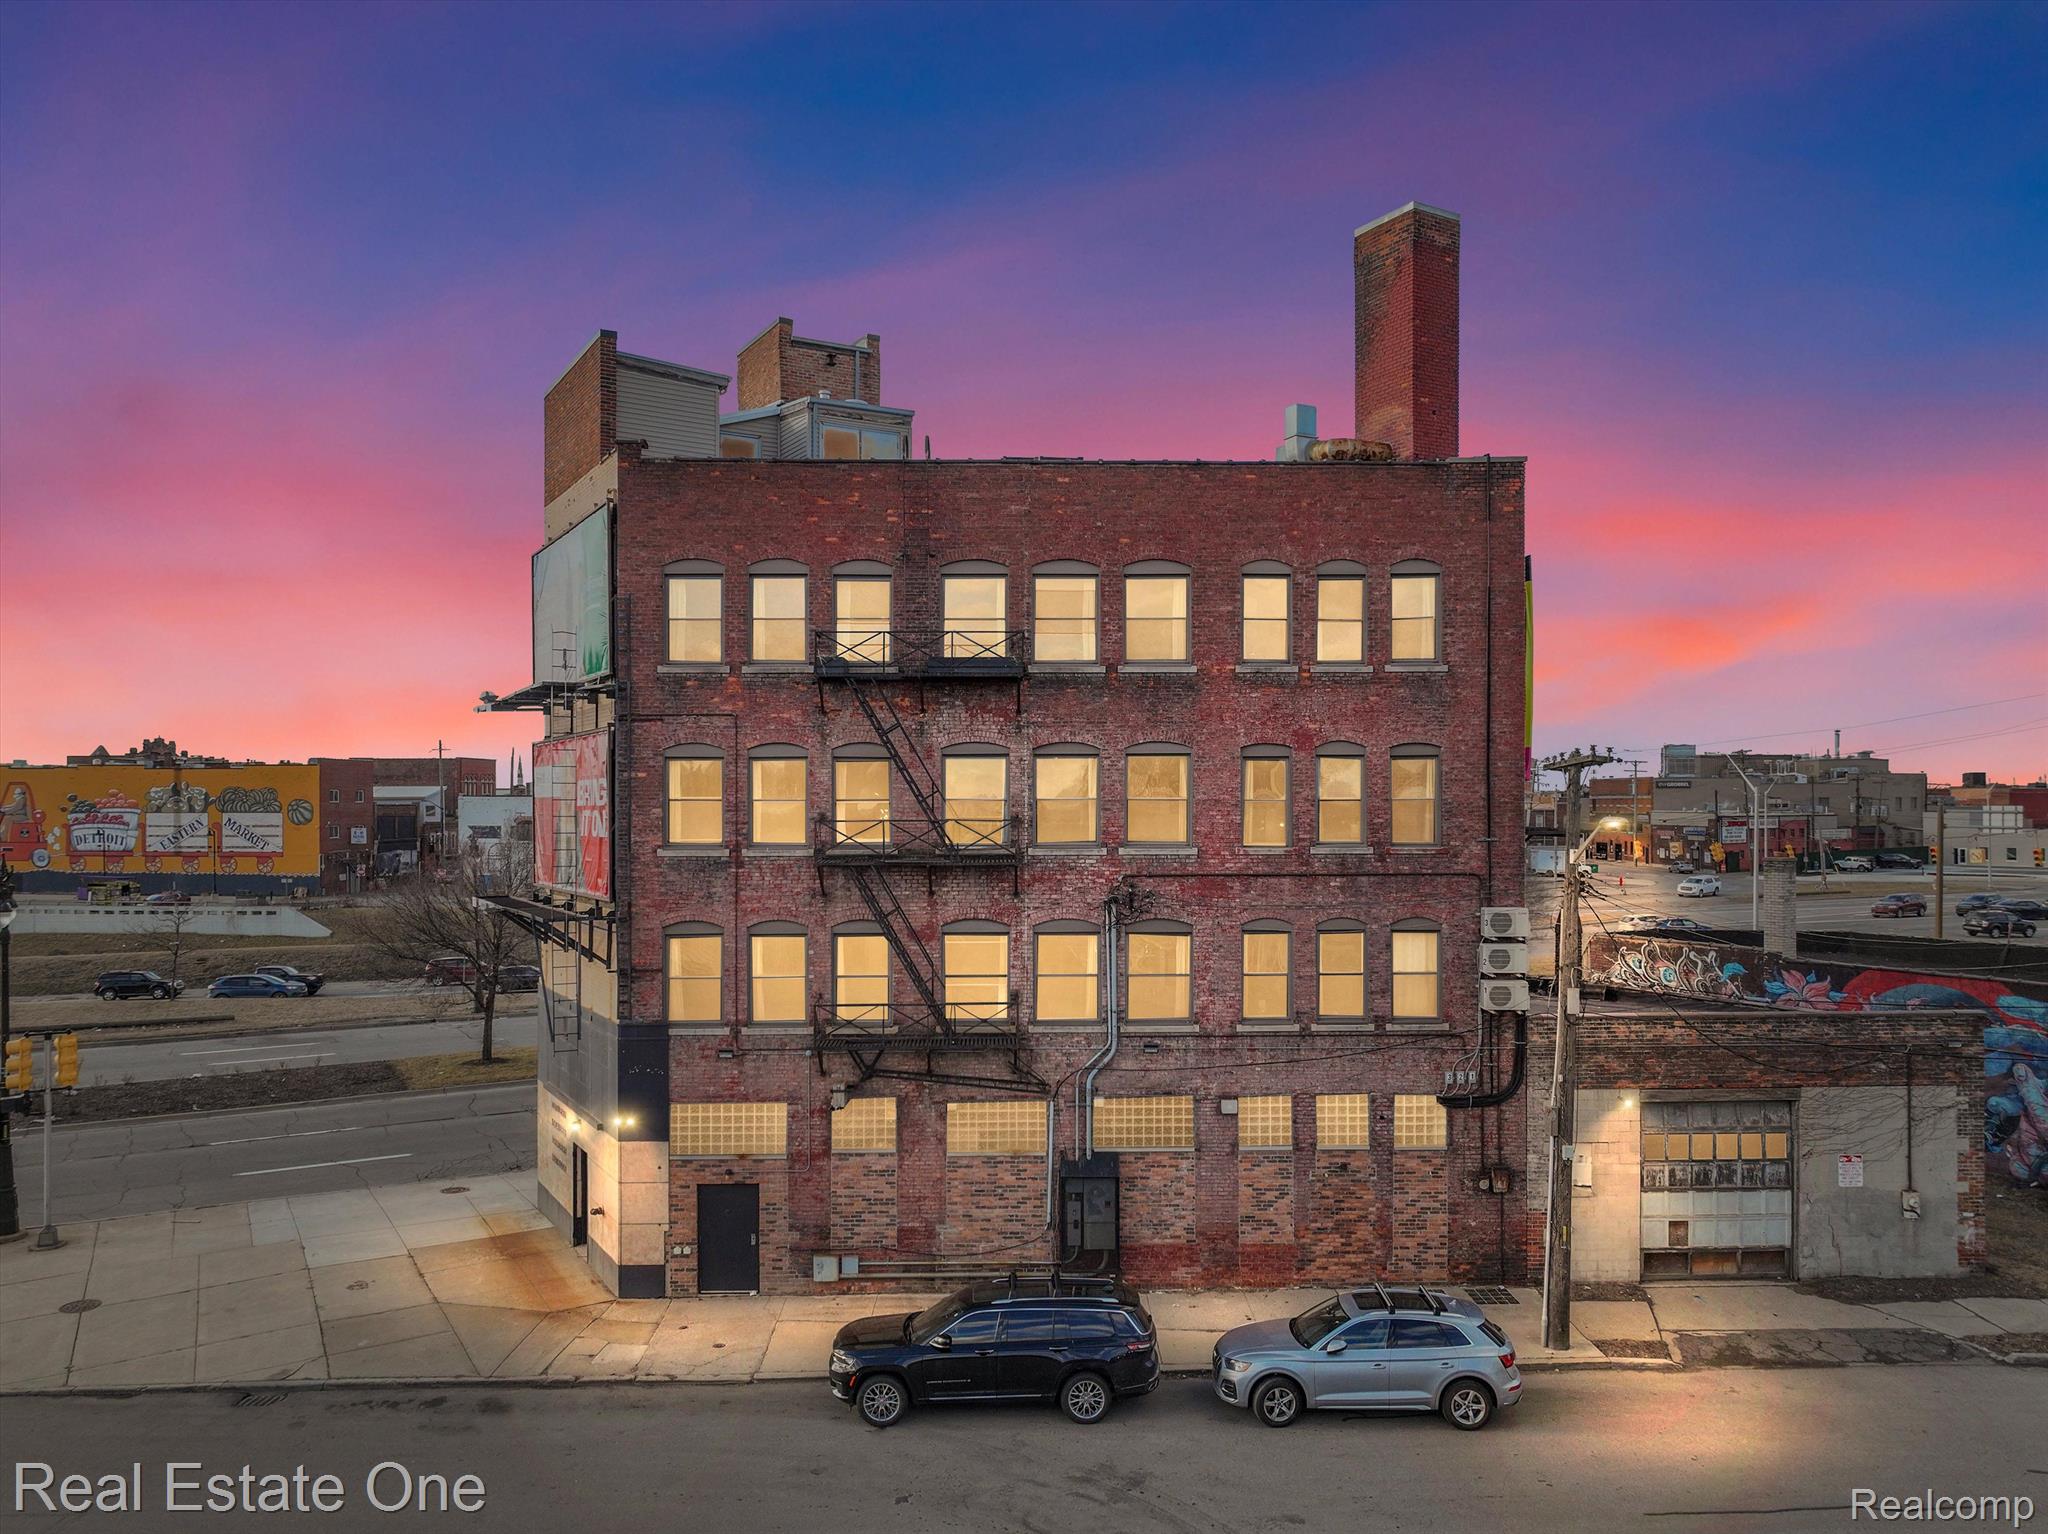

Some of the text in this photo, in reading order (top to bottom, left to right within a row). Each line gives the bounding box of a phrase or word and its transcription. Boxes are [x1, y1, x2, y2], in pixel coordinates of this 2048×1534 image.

[75, 834, 127, 847] DETROIT
[160, 817, 205, 850] EASTERN
[224, 817, 270, 850] MARKET
